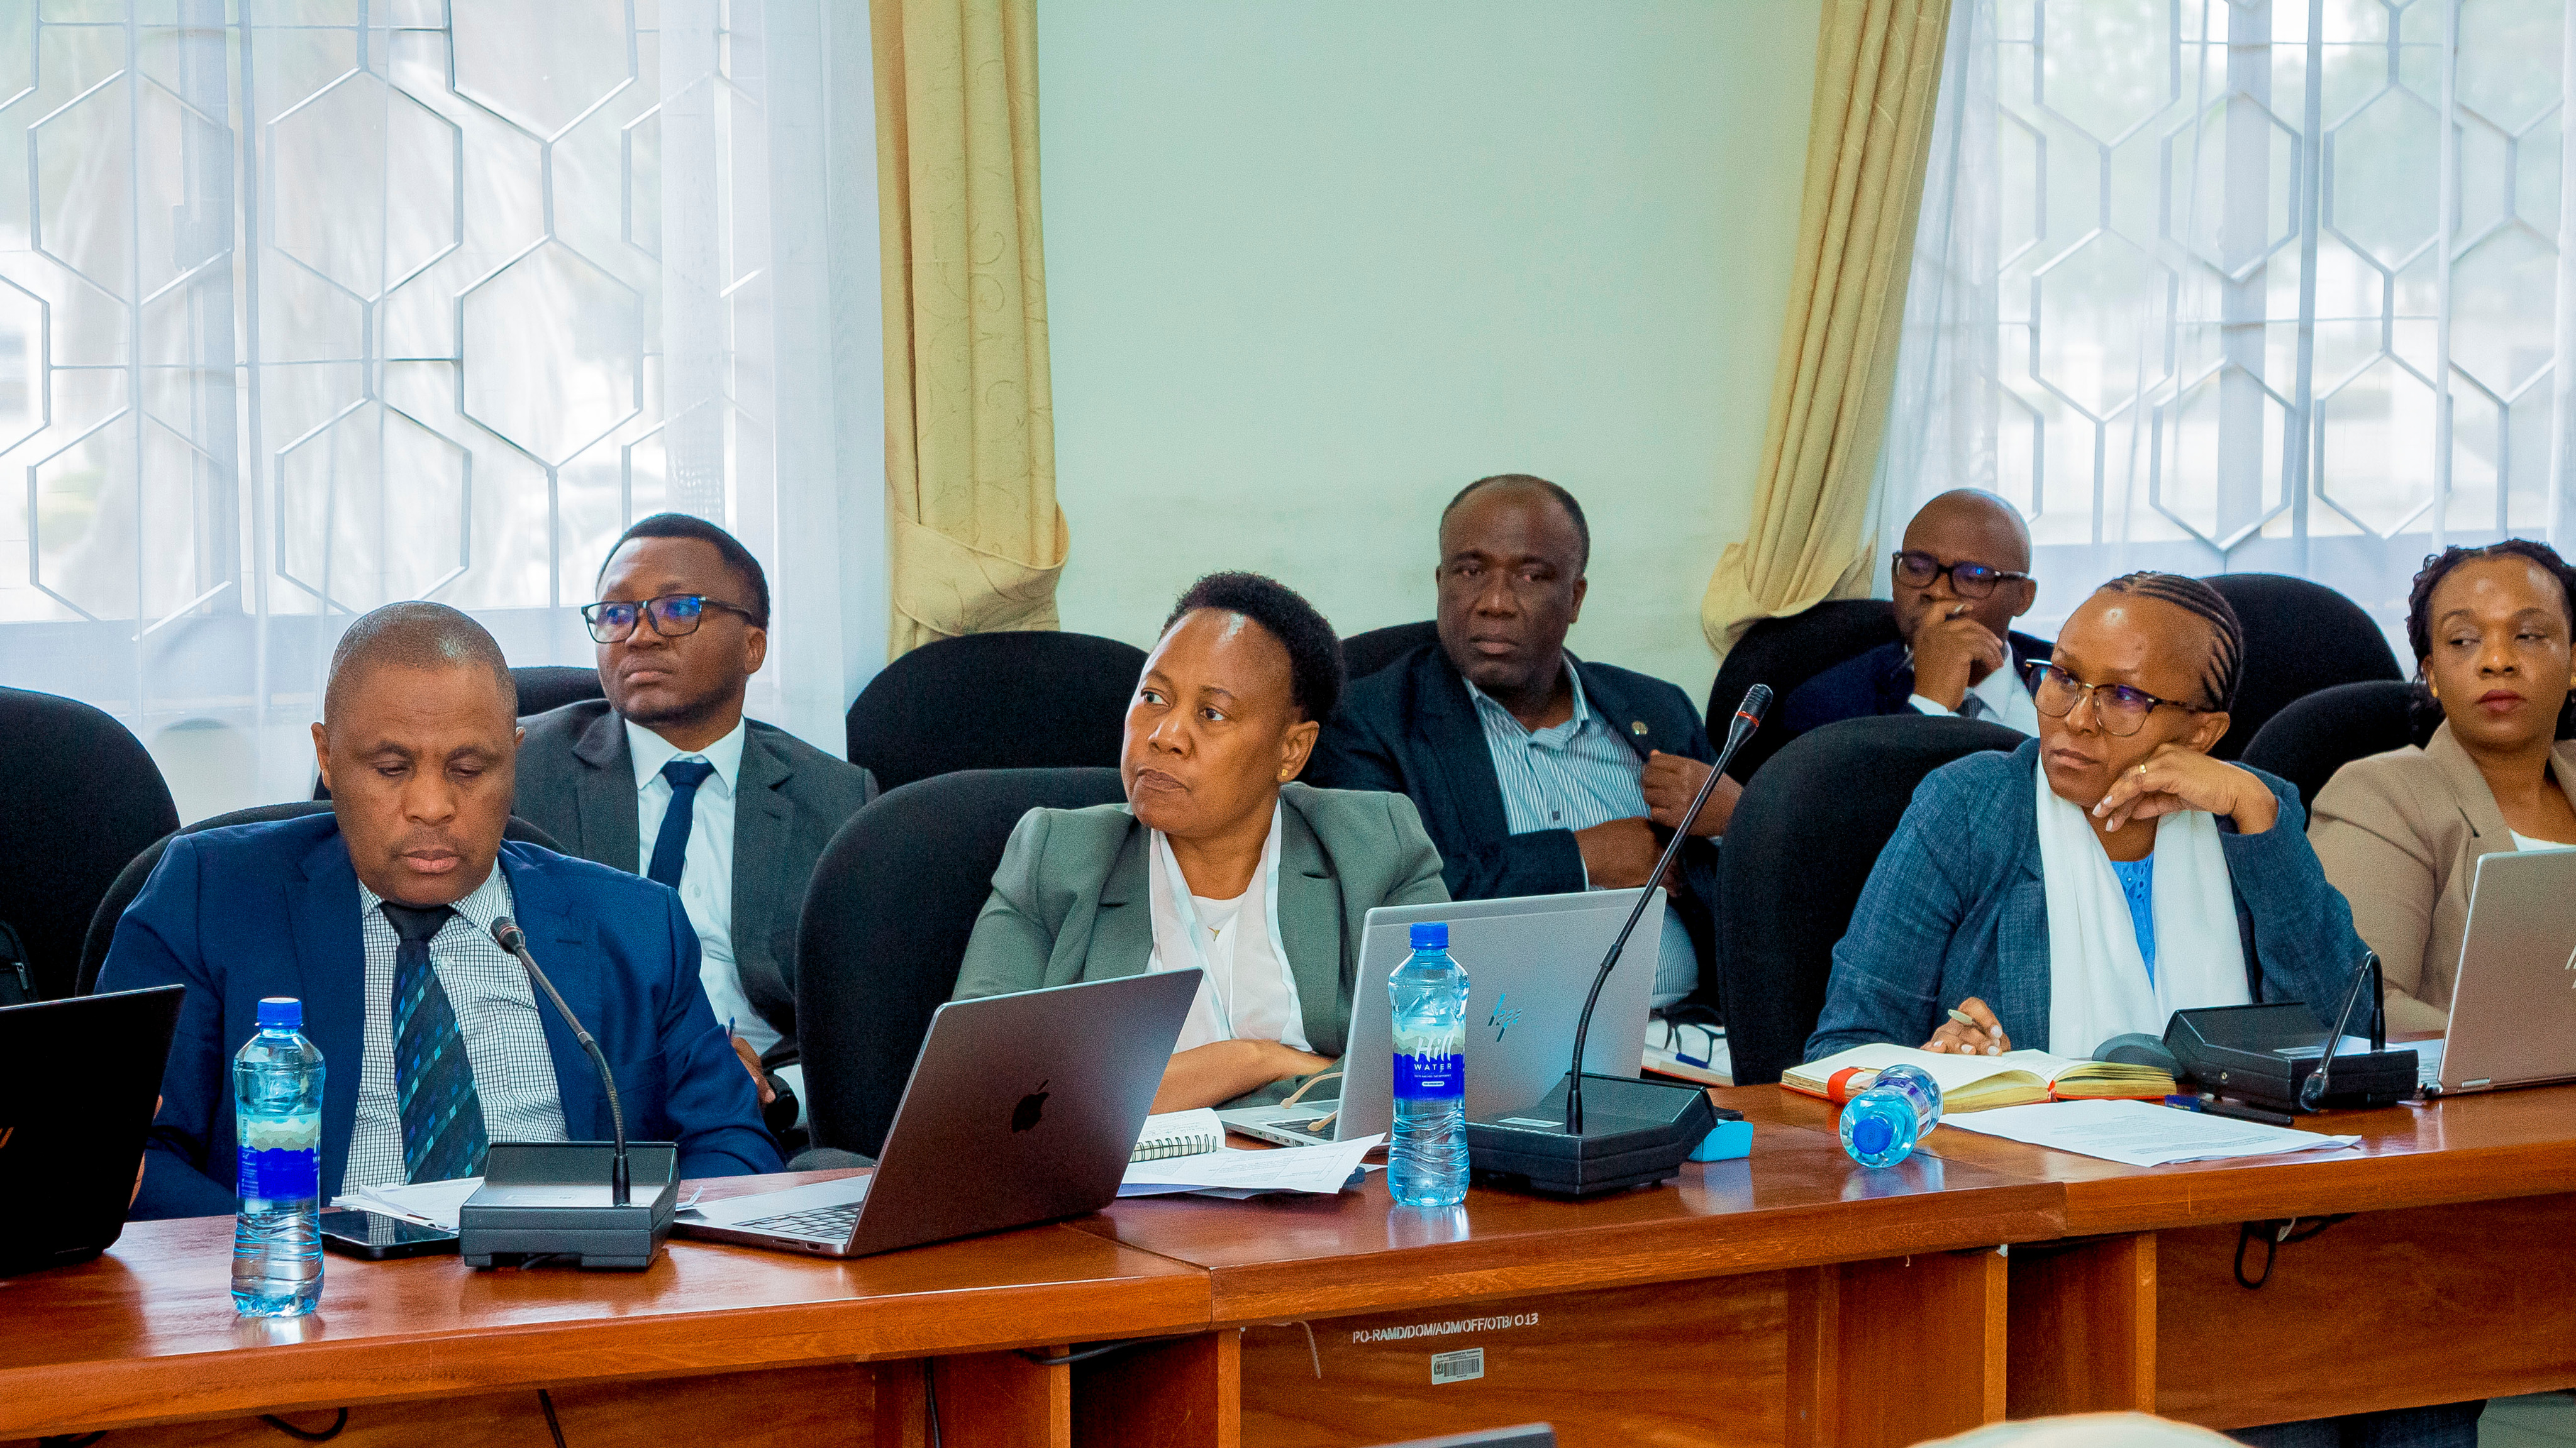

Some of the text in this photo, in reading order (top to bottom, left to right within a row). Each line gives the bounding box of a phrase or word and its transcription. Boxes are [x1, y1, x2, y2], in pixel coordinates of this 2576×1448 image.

[1487, 993, 1522, 1042] hp
[1414, 1032, 1455, 1063] Hill
[1414, 1063, 1452, 1071] WATER
